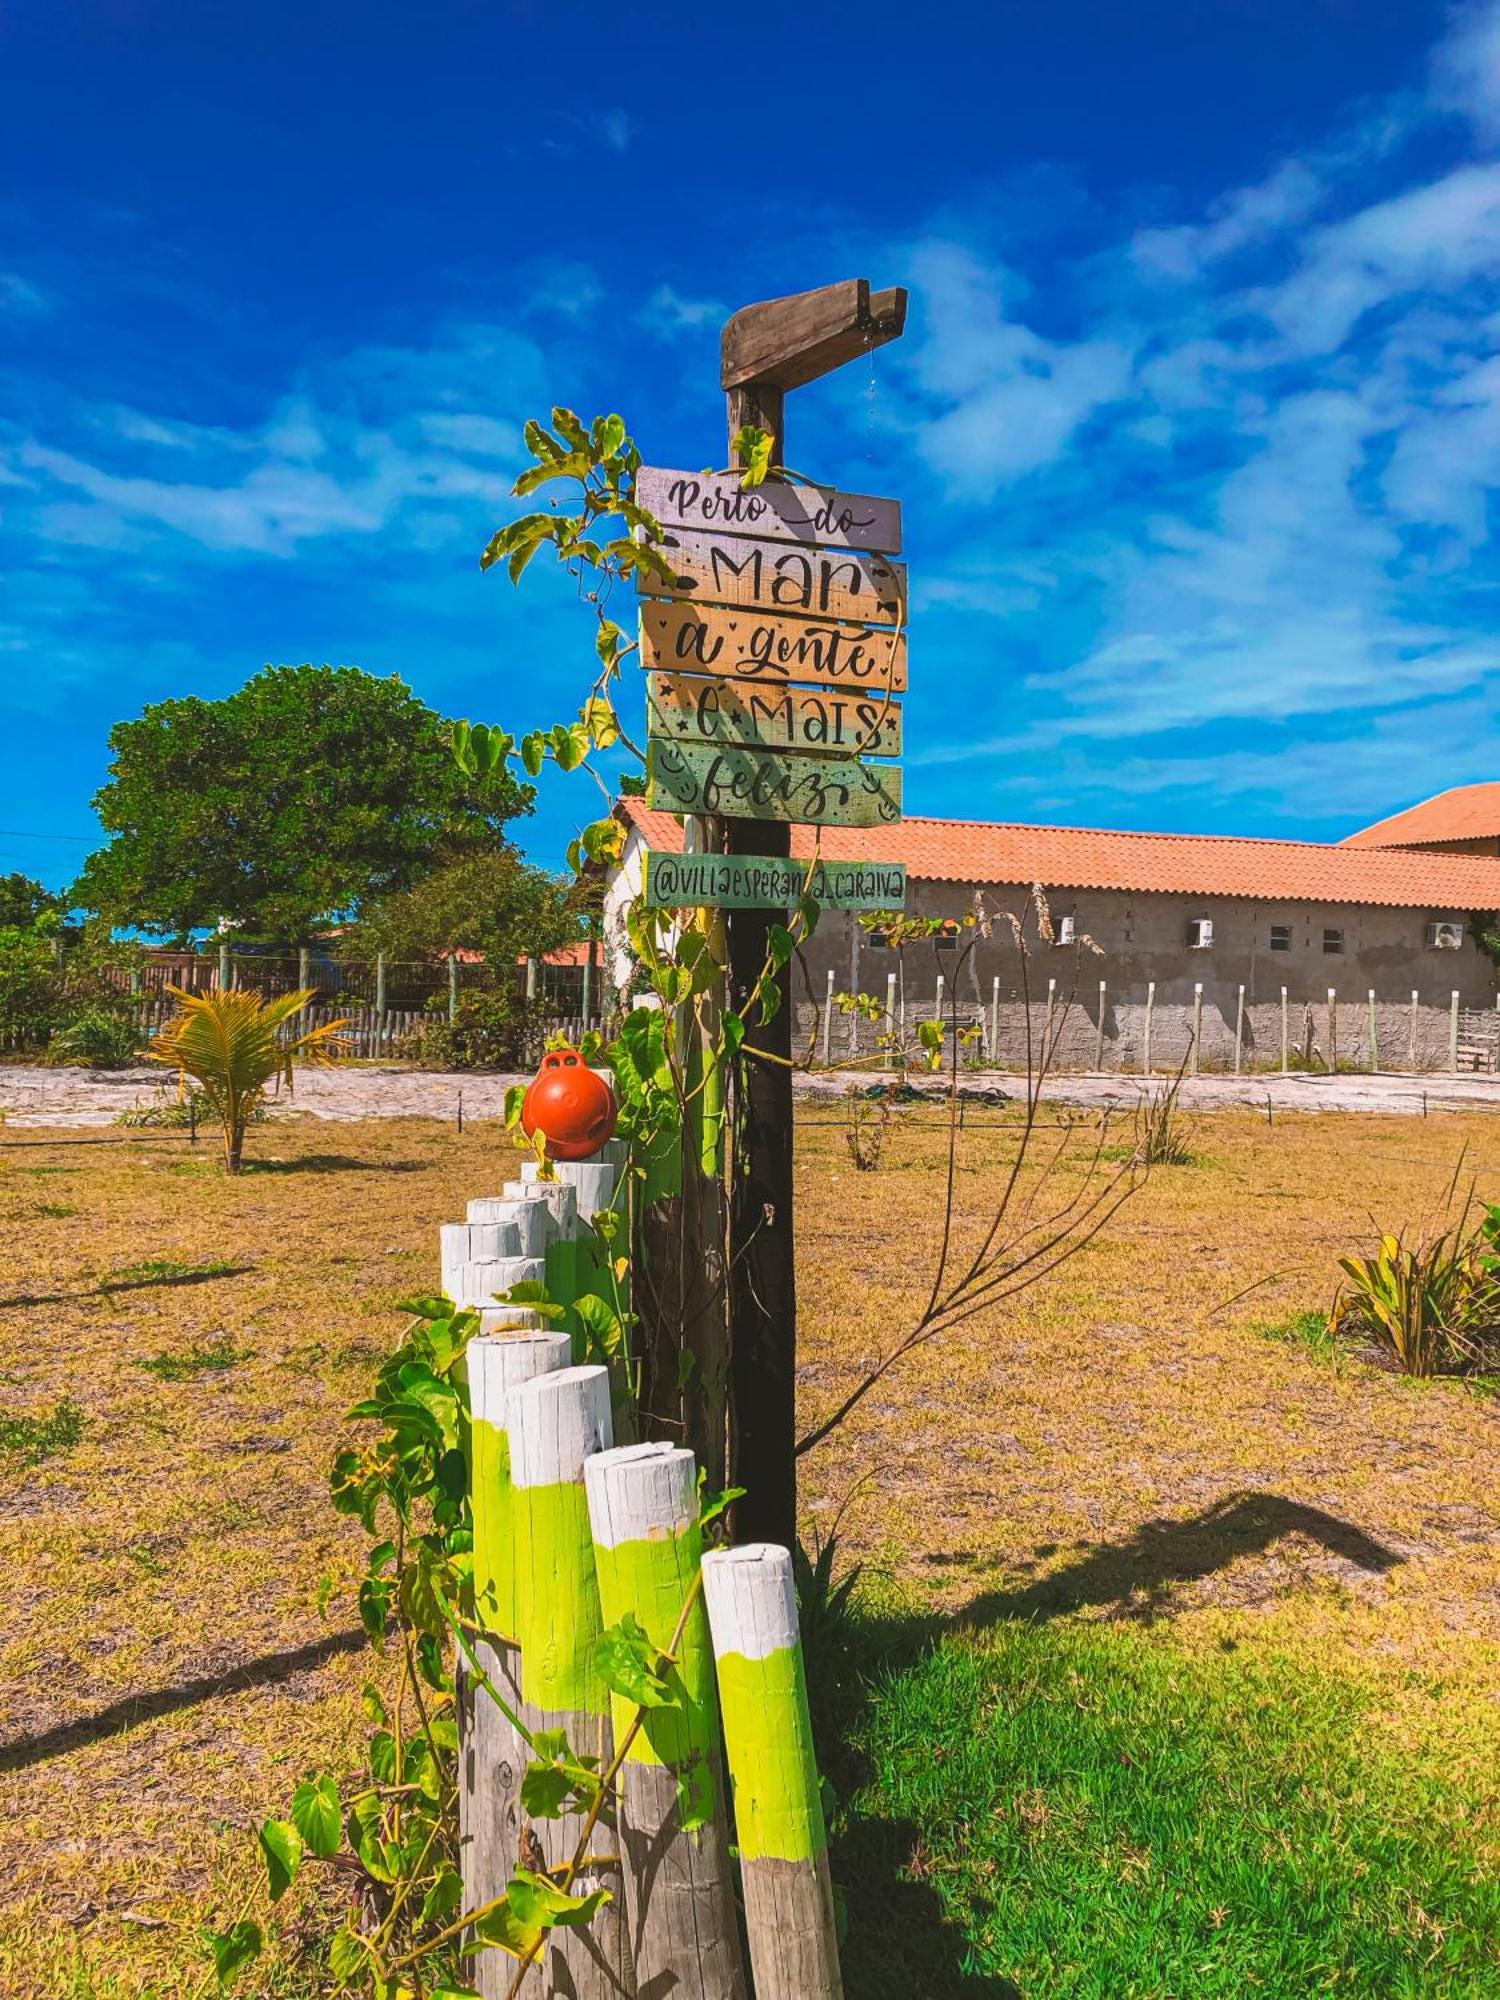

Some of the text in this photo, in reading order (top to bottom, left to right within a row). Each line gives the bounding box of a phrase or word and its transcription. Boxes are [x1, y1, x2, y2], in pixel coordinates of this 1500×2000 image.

[668, 479, 876, 535] Perto do
[710, 546, 862, 612] Mar
[675, 621, 875, 677] a gente
[703, 756, 850, 819] feliz
